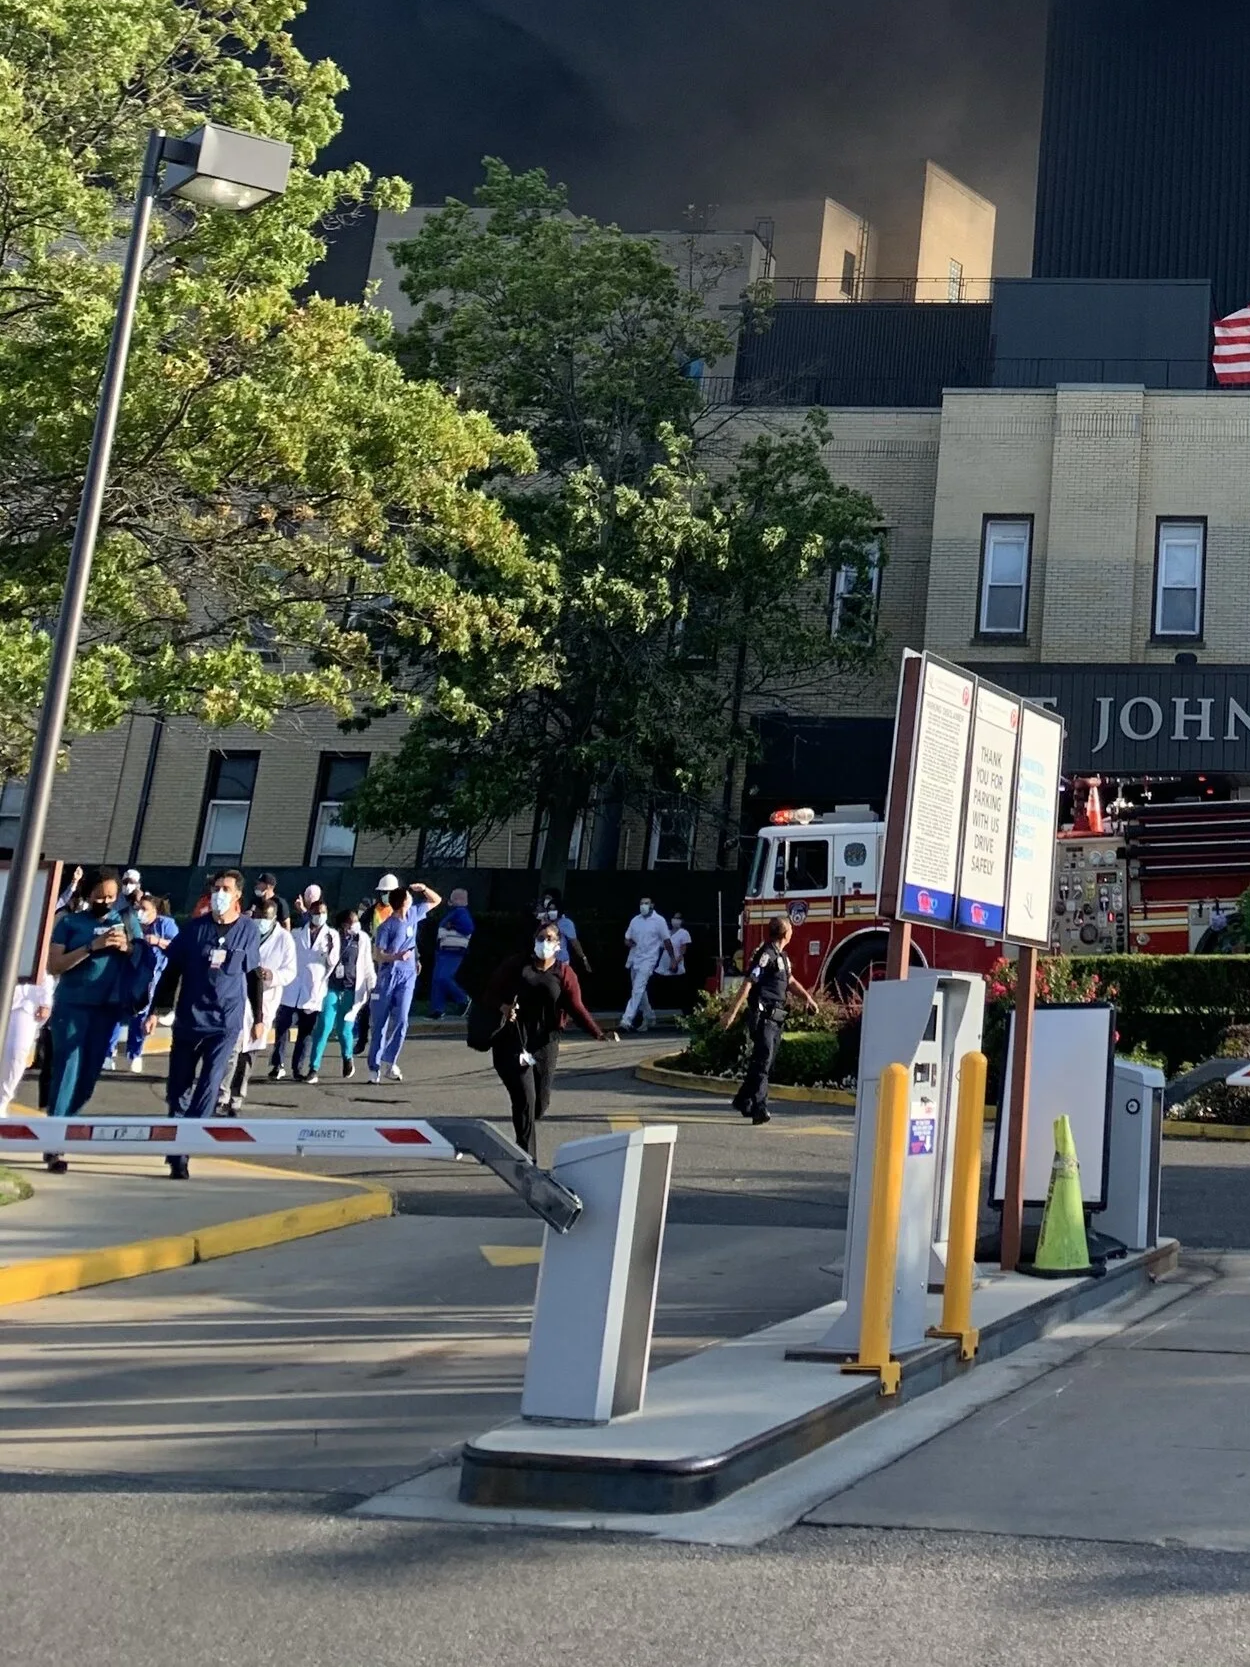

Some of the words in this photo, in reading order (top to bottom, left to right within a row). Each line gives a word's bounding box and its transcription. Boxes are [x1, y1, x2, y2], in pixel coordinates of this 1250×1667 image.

[981, 746, 1003, 769] THANK
[976, 767, 989, 786] YOU
[991, 774, 1004, 791] FOR
[973, 789, 1002, 813] PARKING
[972, 810, 989, 829] WITH
[991, 817, 1000, 834] US
[974, 834, 994, 854] DRIVE
[971, 855, 995, 876] SAFELY
